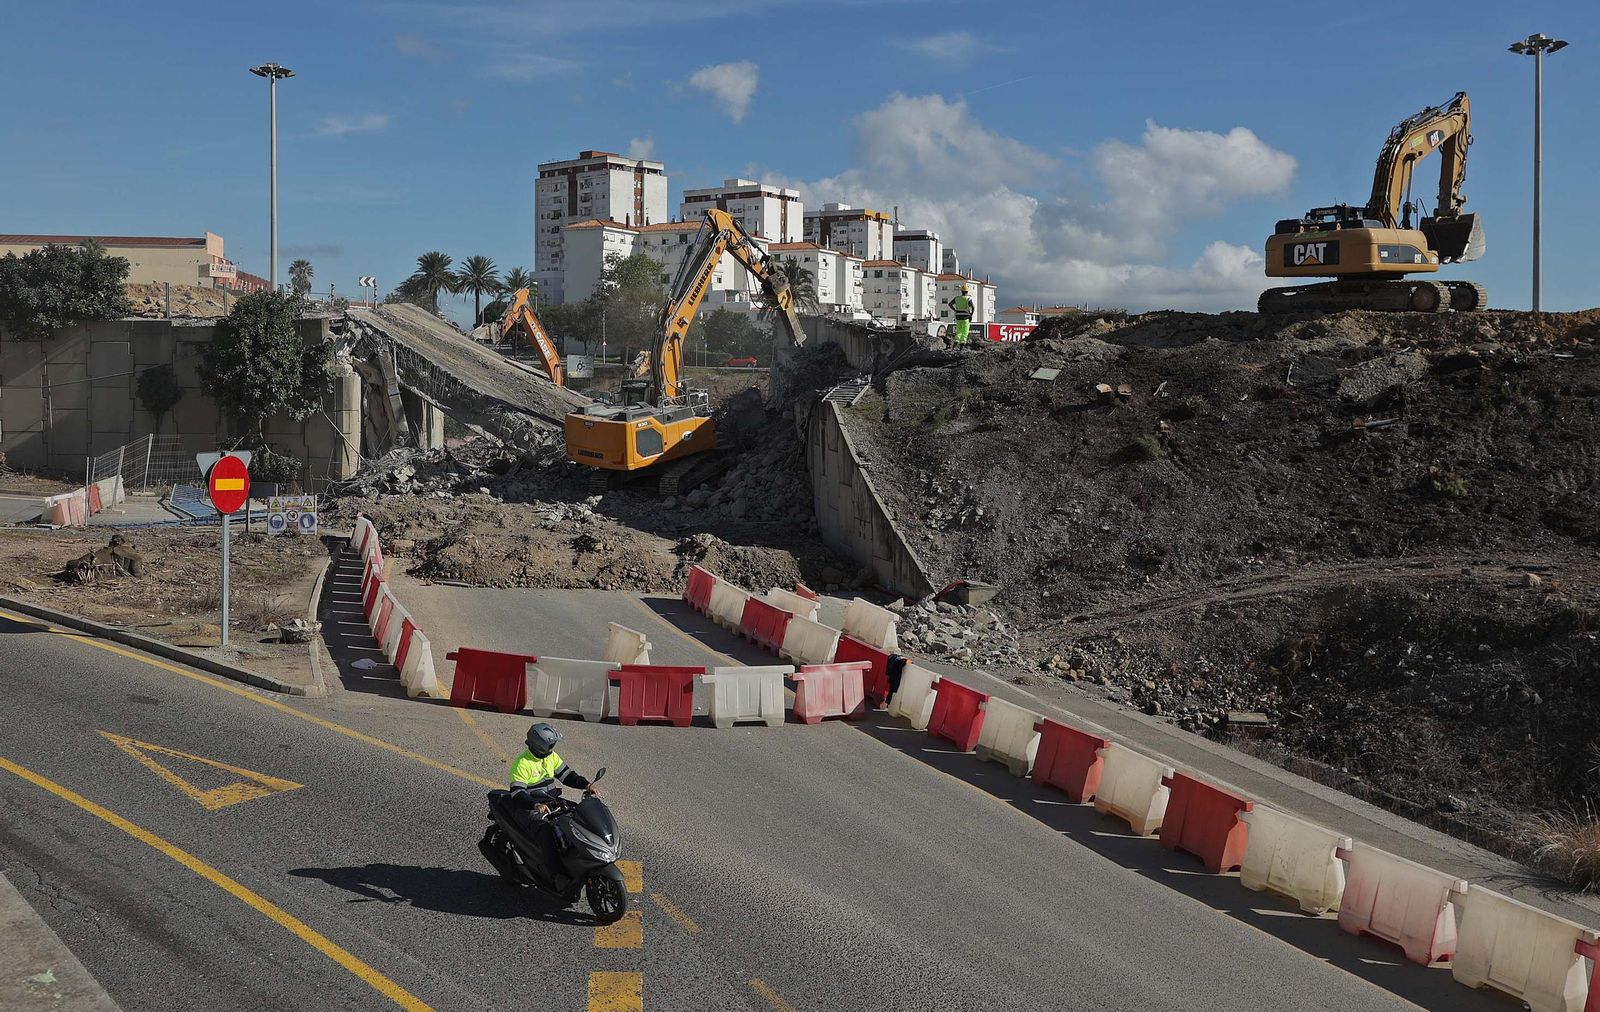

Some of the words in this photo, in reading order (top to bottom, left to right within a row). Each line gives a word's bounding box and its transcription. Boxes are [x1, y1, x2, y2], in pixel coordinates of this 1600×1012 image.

[1293, 243, 1328, 265] CAT
[688, 262, 714, 306] LIEBHERR
[535, 332, 551, 358] CASE
